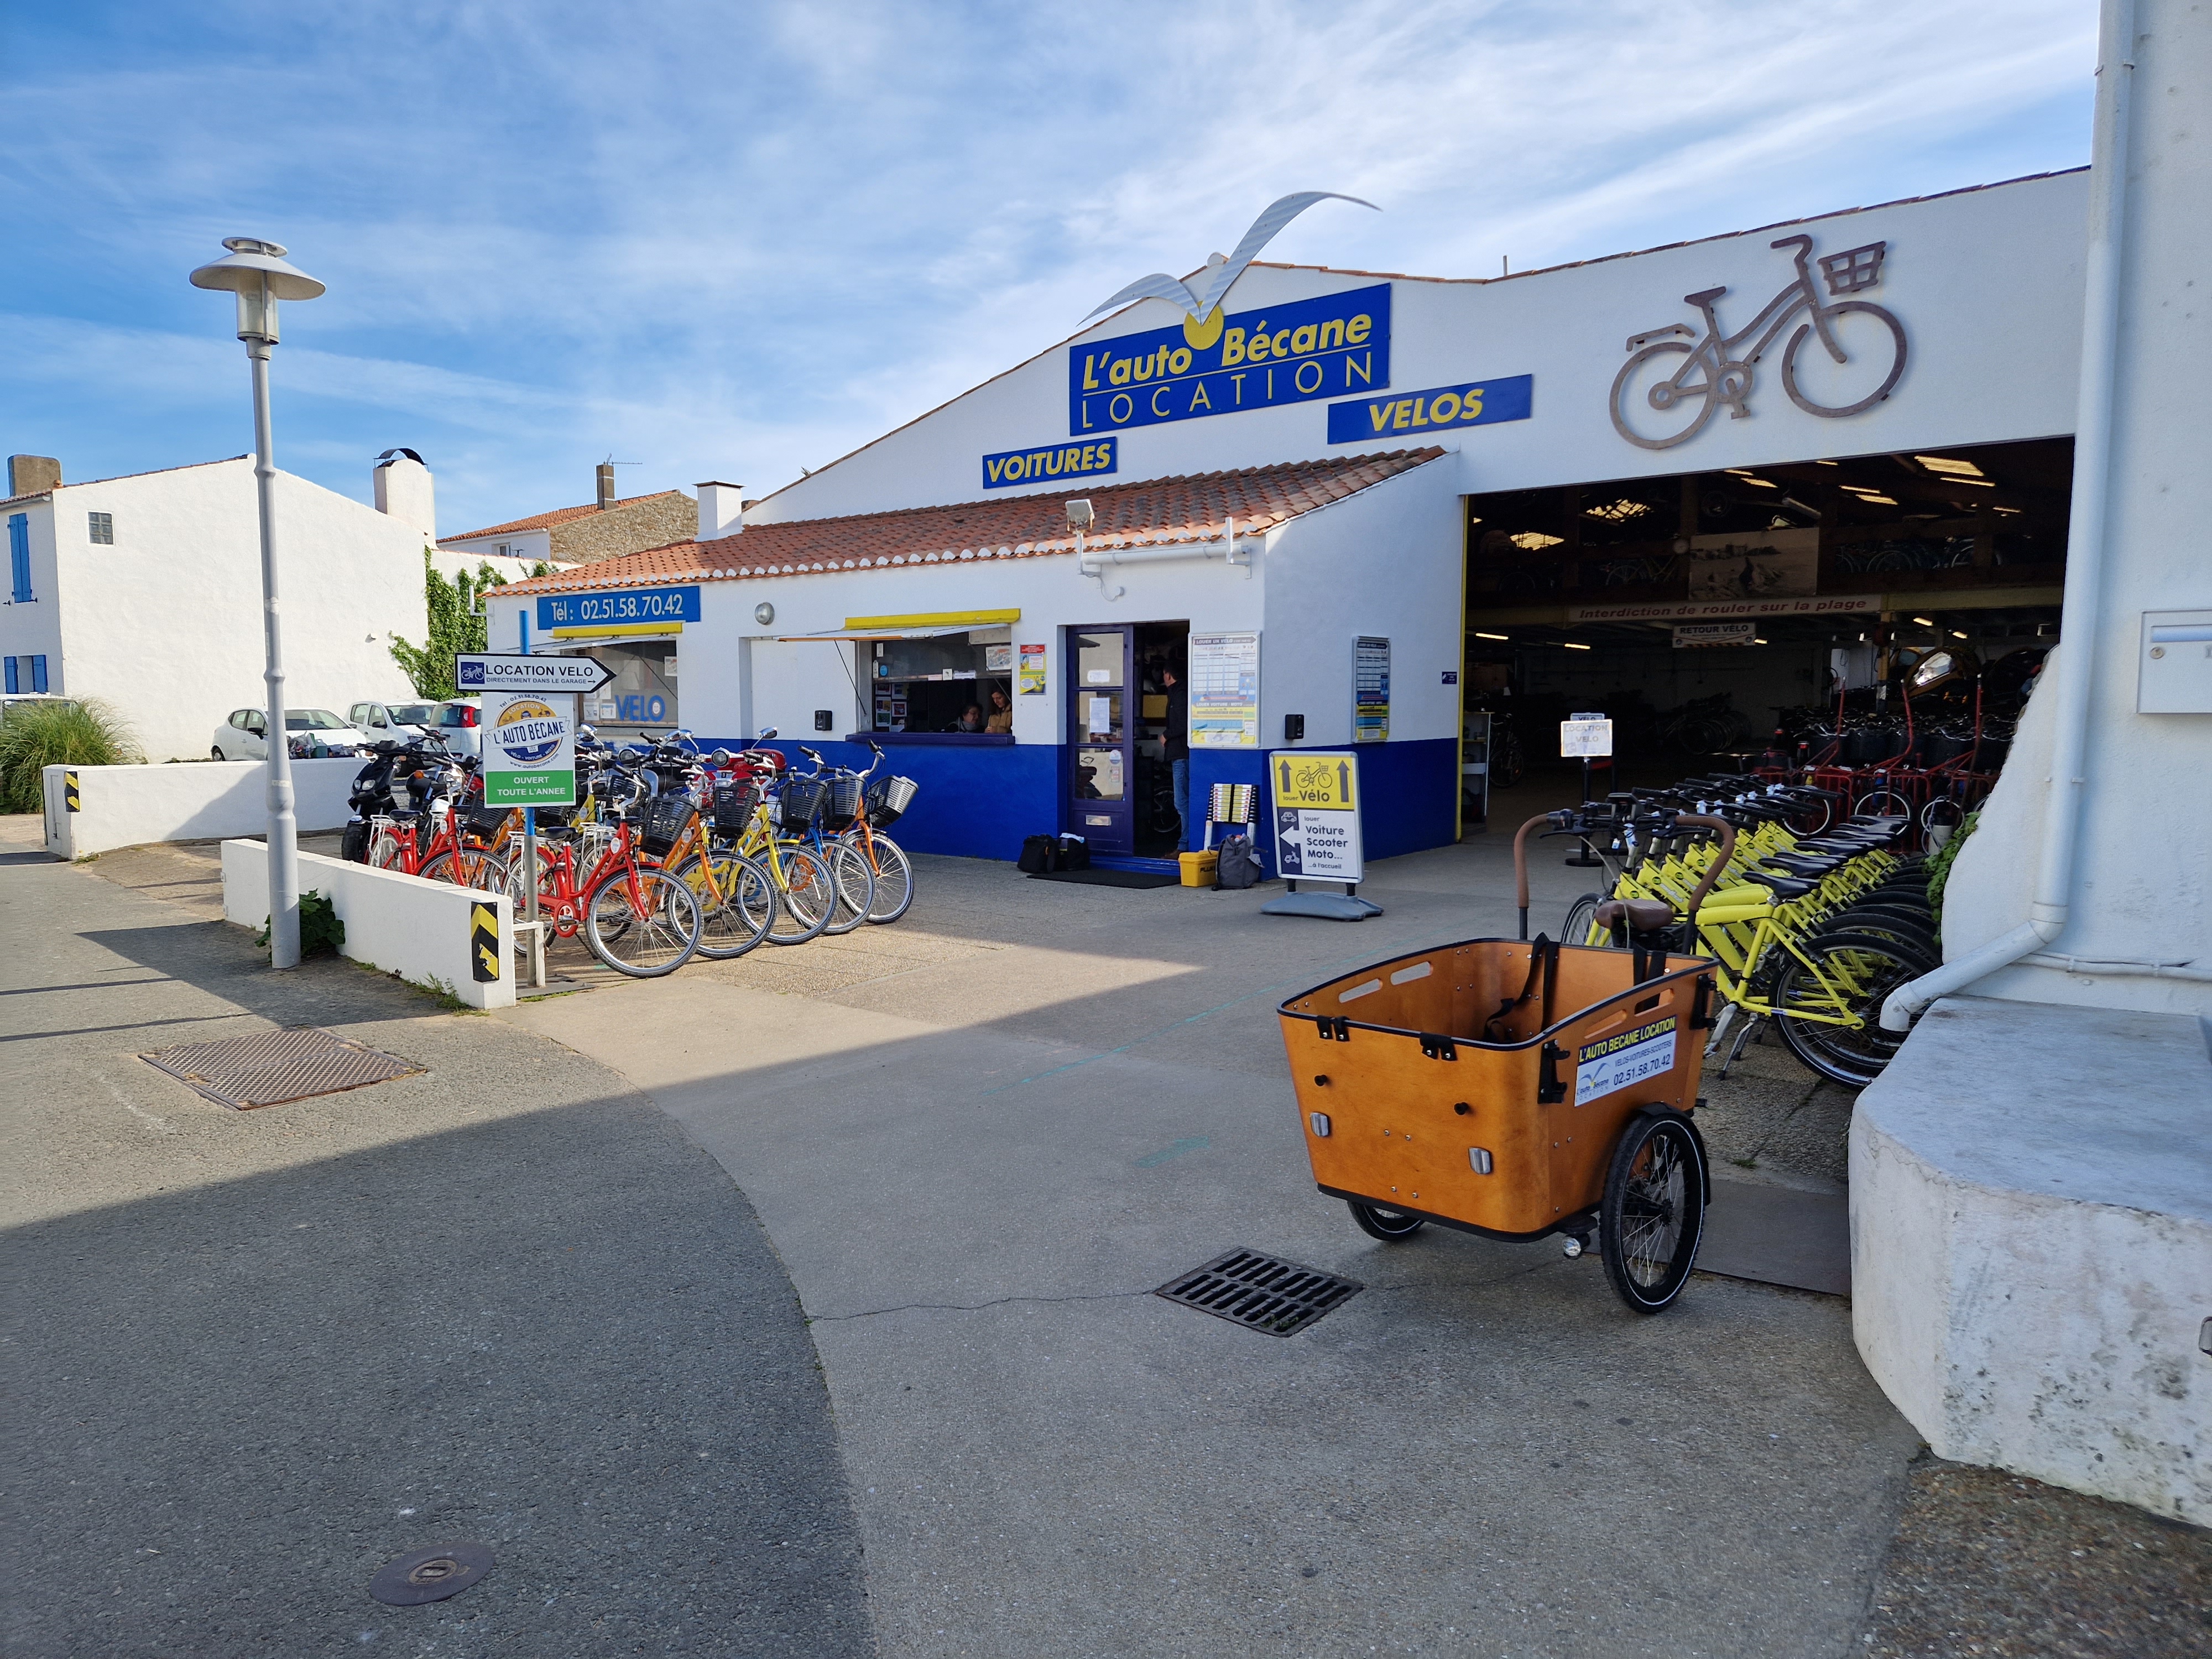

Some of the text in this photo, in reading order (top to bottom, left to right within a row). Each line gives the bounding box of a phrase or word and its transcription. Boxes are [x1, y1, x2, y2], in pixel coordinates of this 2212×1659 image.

[1082, 313, 1372, 390] L'auto Bécane
[1082, 352, 1371, 429] LOCATION
[1368, 388, 1484, 432] VELOS
[986, 442, 1112, 483] VOITURES
[581, 593, 684, 620] 02.51.58.70.42
[1579, 599, 1867, 619] Interdiction de rouler sur la plage
[486, 665, 593, 676] LOCATION VELO
[507, 703, 540, 715] LOCATION
[614, 695, 666, 722] VELO
[493, 721, 565, 744] L'AUTO BÉCANE
[545, 744, 555, 755] MOTO
[1298, 789, 1330, 802] Vélo
[1306, 825, 1344, 836] Voiture
[1307, 838, 1348, 848] Scooter
[1579, 1016, 1676, 1063] L'AUTO BECANE LOCATION
[1614, 1053, 1671, 1086] 02.51.58.70.42
